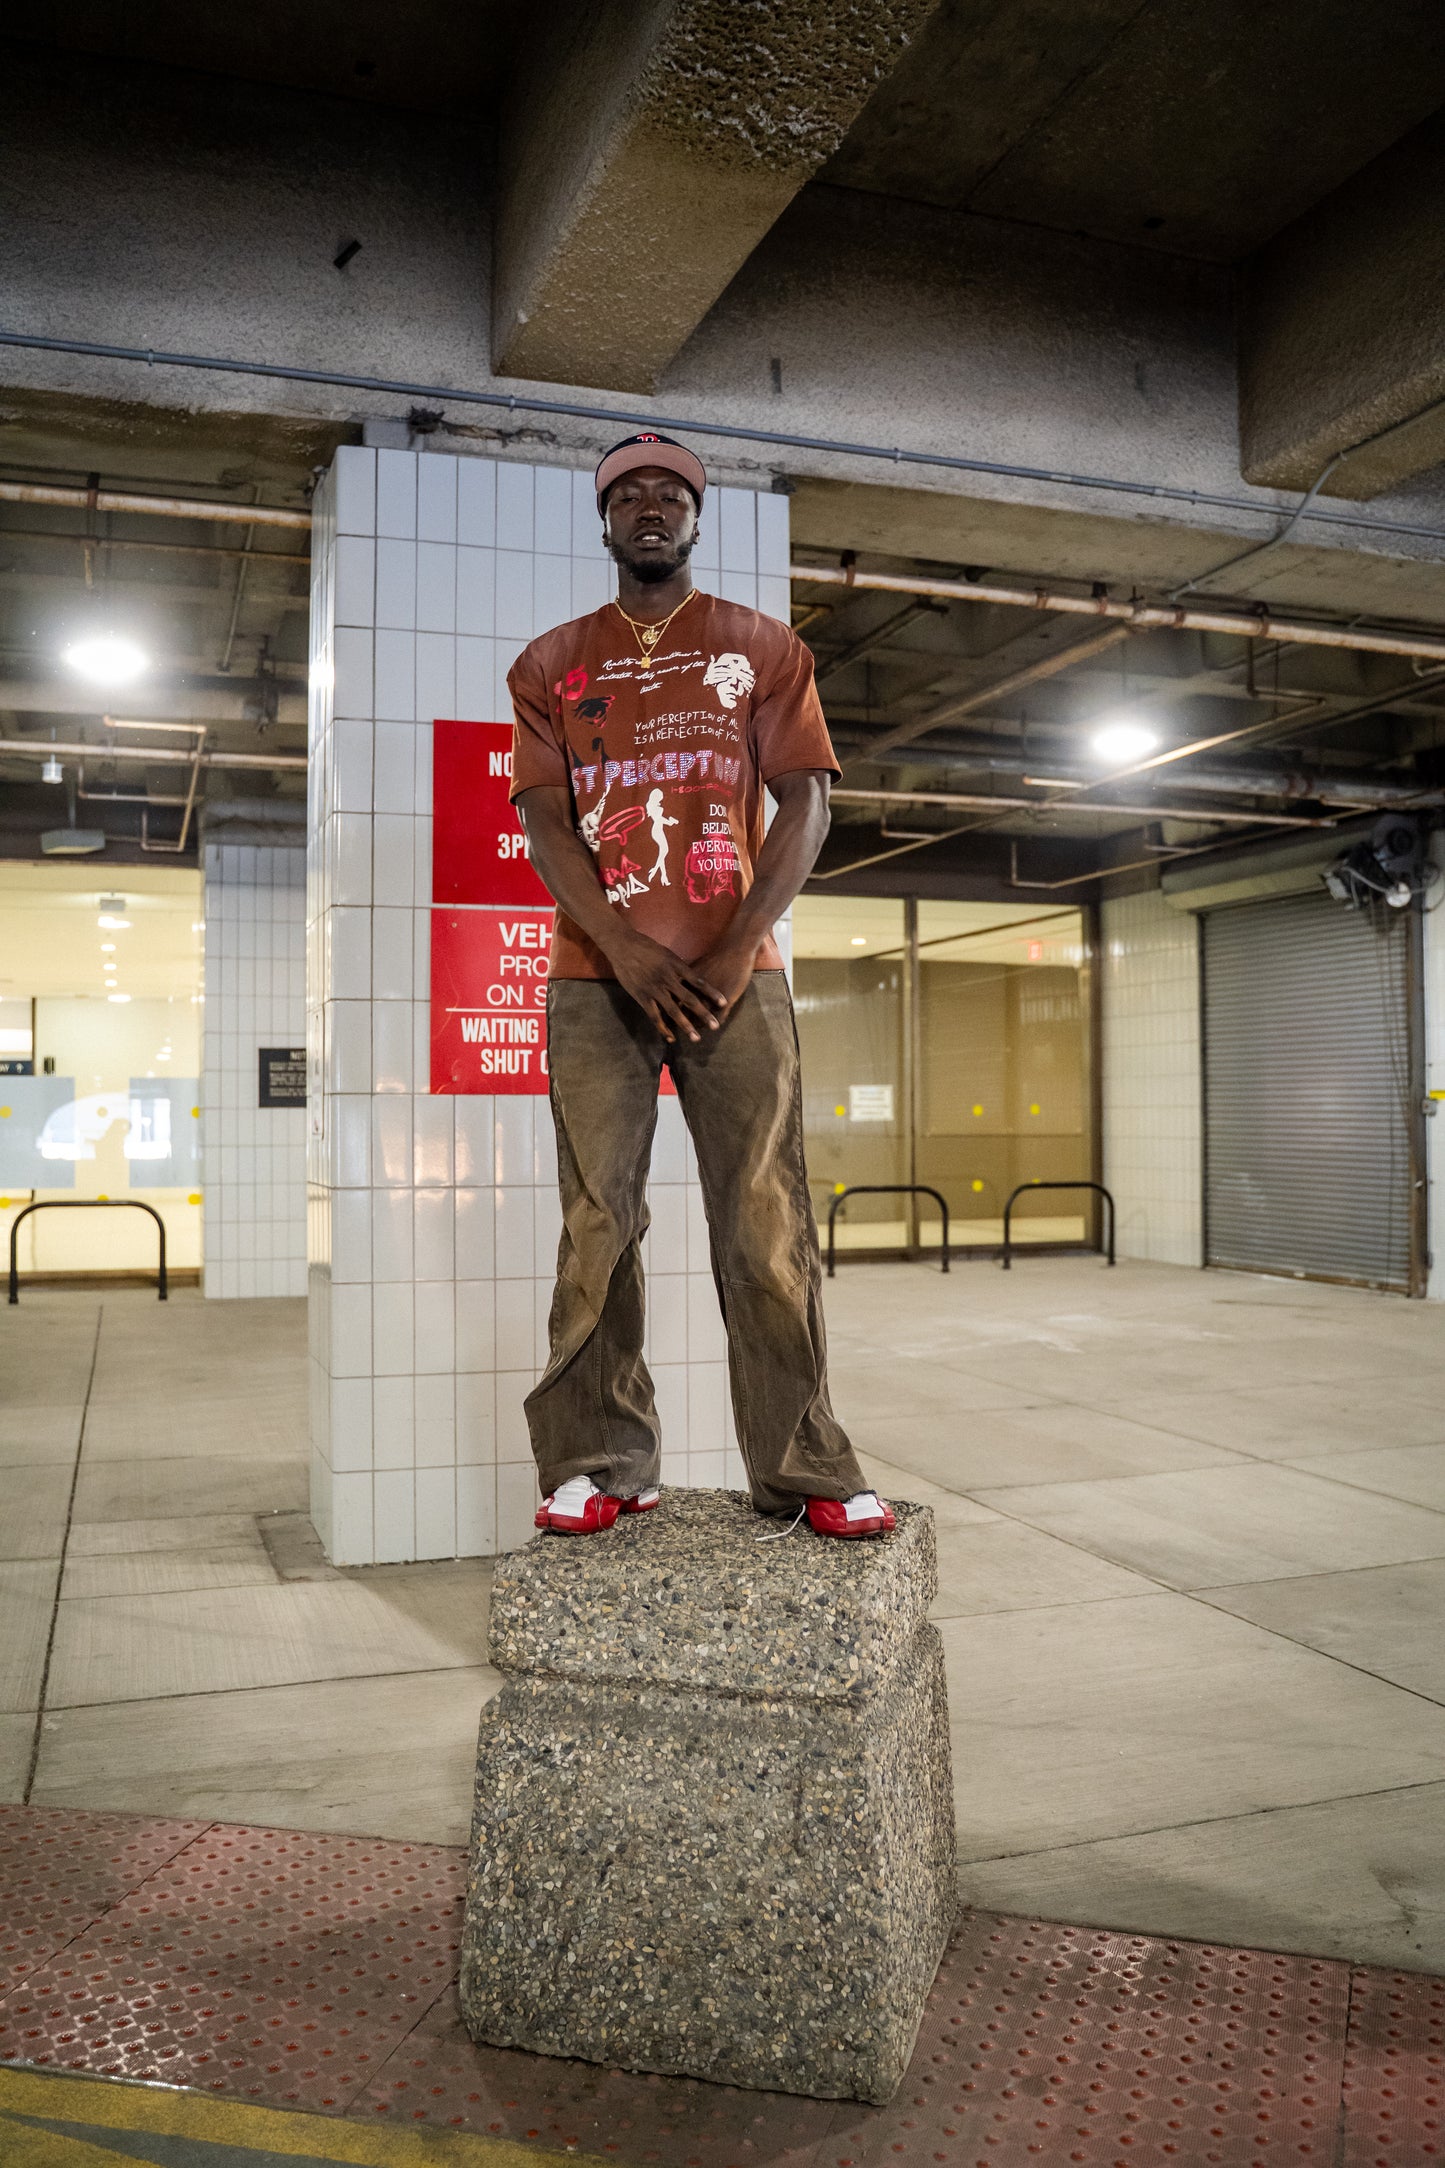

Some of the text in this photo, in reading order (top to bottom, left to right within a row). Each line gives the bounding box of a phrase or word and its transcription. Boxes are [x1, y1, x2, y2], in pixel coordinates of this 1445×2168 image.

[633, 735, 647, 745] IS
[648, 733, 655, 743] A
[697, 858, 722, 872] YOU
[486, 984, 524, 1006] ON
[461, 1017, 539, 1044] WAITING
[481, 1049, 532, 1075] SHUT
